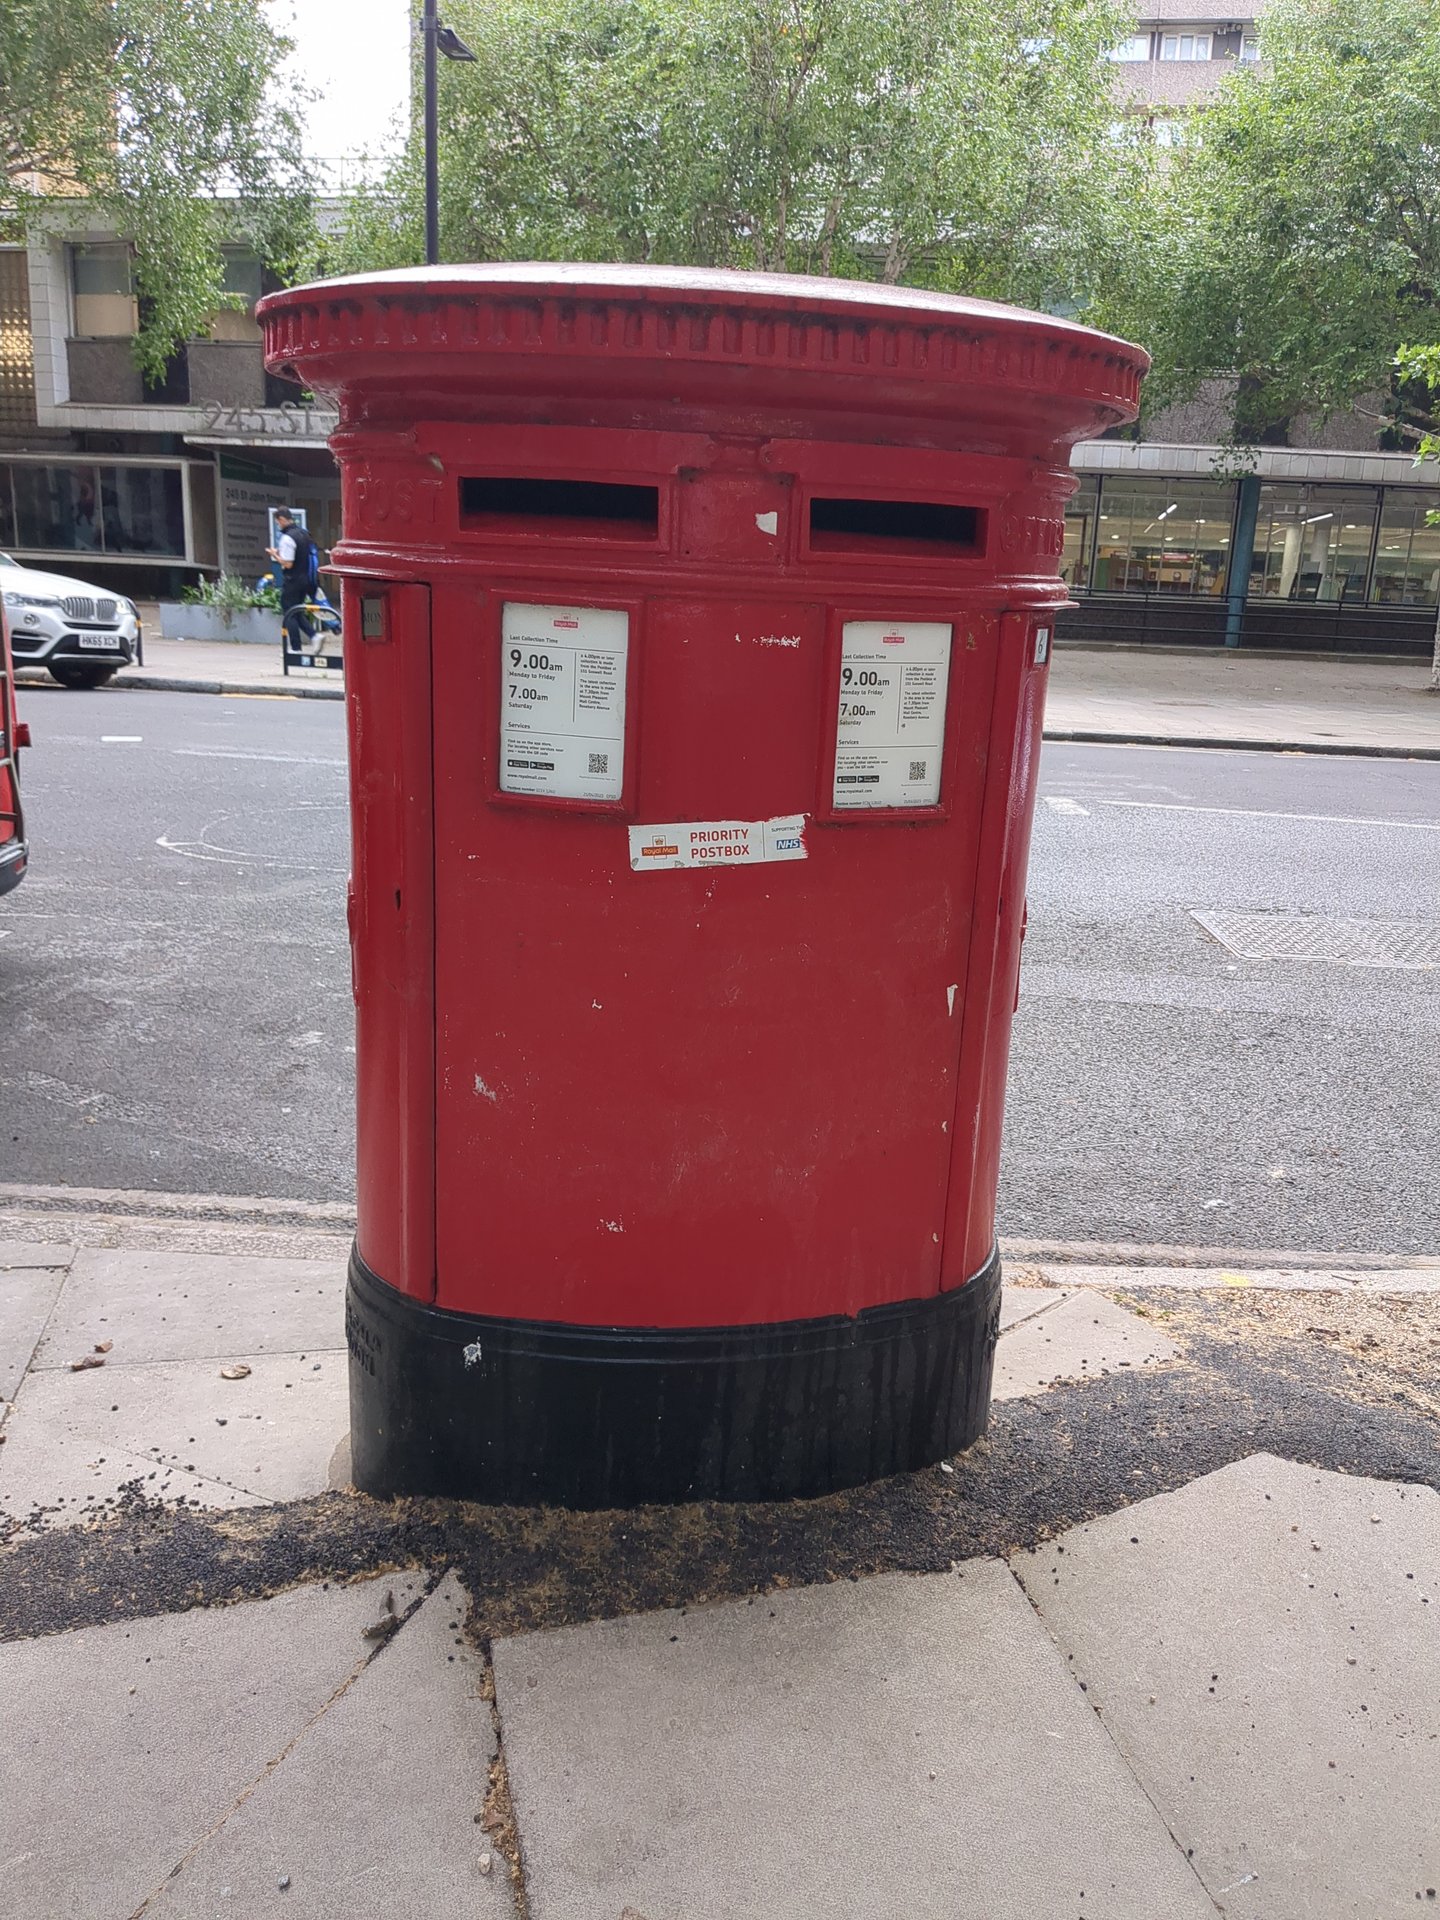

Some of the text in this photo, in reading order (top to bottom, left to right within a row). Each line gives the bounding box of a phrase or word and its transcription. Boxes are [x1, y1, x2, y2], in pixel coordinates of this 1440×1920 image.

[202, 400, 314, 434] 245 ST
[510, 649, 563, 671] 9.00am
[509, 671, 530, 679] Monday
[842, 668, 890, 686] 9.00am
[509, 685, 548, 701] 7.00am
[840, 703, 876, 716] 7.00am
[690, 829, 749, 843] PRIORITY
[778, 840, 799, 849] NHS
[691, 845, 750, 859] POSTBOX
